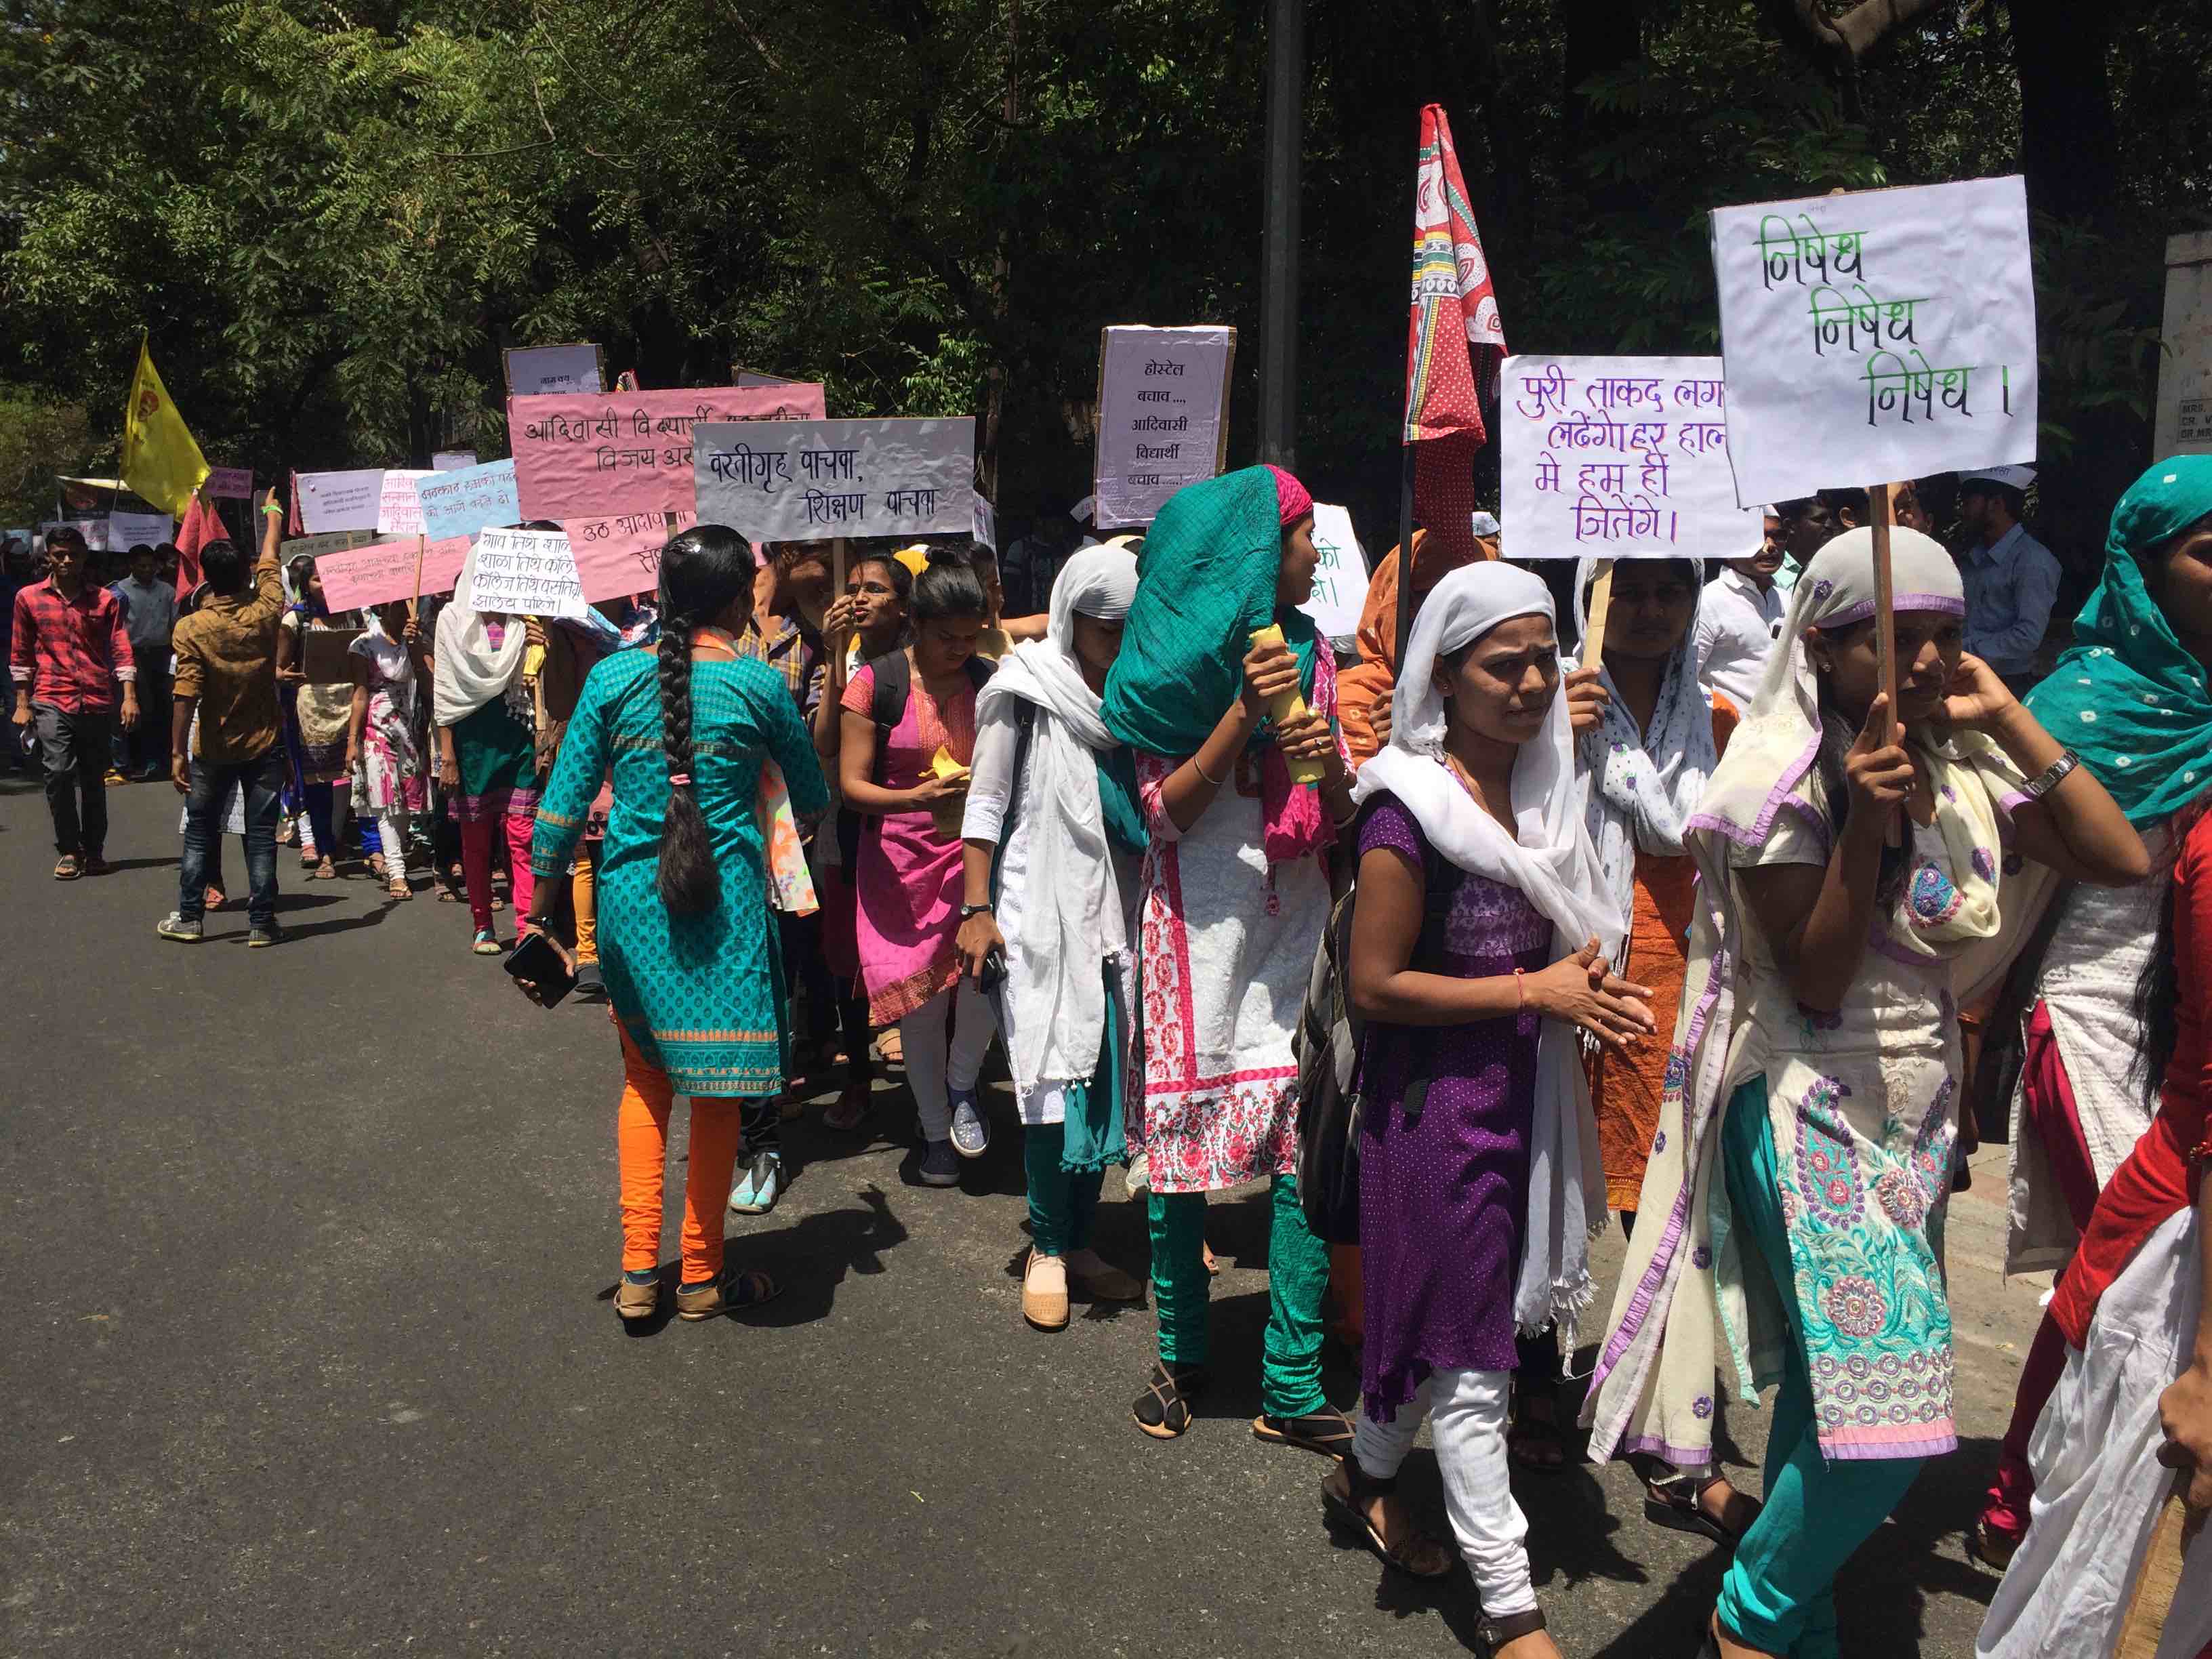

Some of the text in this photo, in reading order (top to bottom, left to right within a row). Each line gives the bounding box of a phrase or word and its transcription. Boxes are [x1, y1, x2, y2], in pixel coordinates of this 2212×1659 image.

[1752, 213, 1869, 291] निषेध
[1807, 283, 1929, 357] निषेध
[1145, 359, 1185, 375] होस्टेल
[1517, 364, 1578, 420] पुरी
[1586, 377, 1664, 413] ताकद
[525, 407, 618, 441] आदिवासी
[1132, 415, 1187, 431] आदिवासी
[1136, 443, 1181, 459] विद्यार्थी
[1629, 422, 1668, 455] हर
[596, 445, 655, 472] विजय
[1578, 464, 1629, 497] हम
[1639, 451, 1671, 499] ही
[798, 489, 867, 523] शिक्षण
[511, 532, 538, 551] तिथे
[478, 553, 514, 570] शाळा
[516, 552, 544, 573] तिथे
[473, 571, 515, 591] कॉलेज
